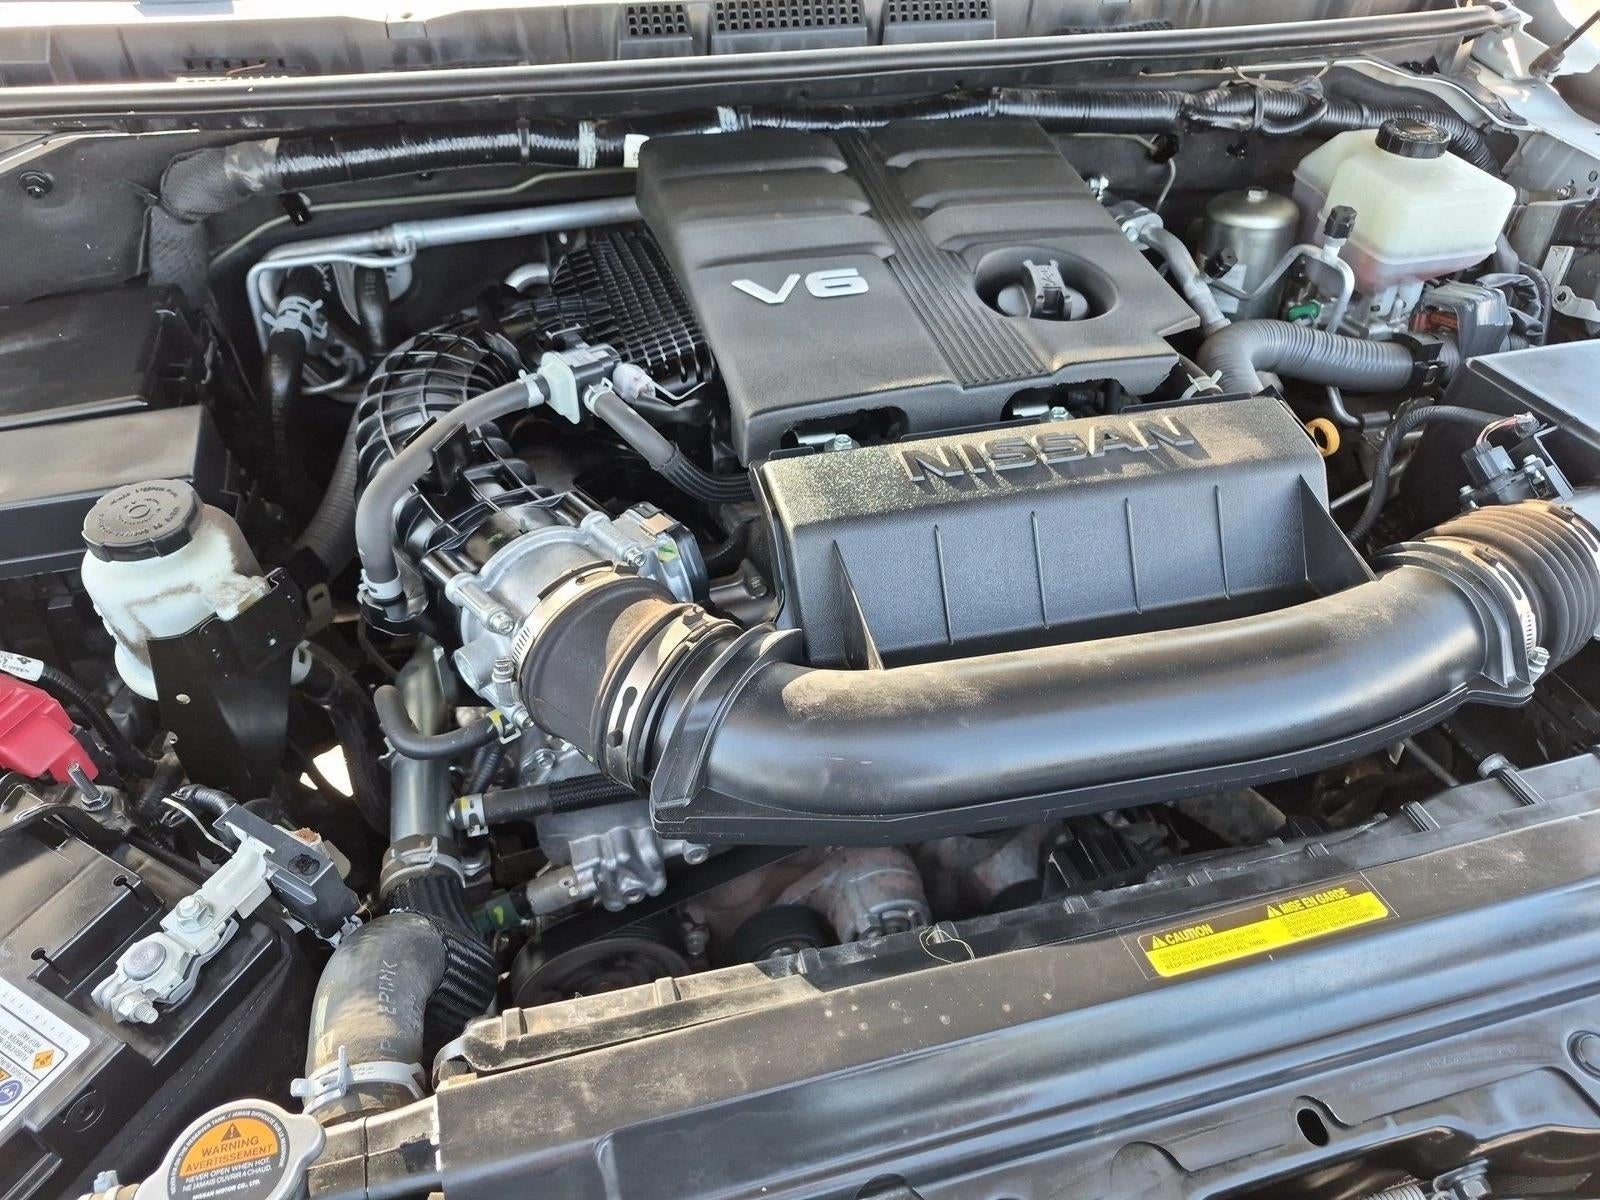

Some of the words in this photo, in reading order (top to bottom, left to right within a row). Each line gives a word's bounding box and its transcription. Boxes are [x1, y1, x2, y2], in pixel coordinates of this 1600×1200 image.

[731, 267, 869, 304] V6
[901, 415, 1194, 482] NISSAN
[1278, 899, 1306, 914] MISE
[1301, 895, 1318, 908] EN
[1315, 887, 1351, 903] GARDE
[1164, 923, 1214, 945] CAUTION
[186, 1144, 273, 1172] AVERTISSEMENT
[202, 1136, 259, 1157] WARNING
[182, 1184, 192, 1192] NE
[192, 1178, 216, 1190] JAMAIS
[216, 1172, 241, 1184] OUVRIR
[186, 1172, 208, 1184] NEVER
[210, 1166, 230, 1177] OPEN
[232, 1161, 254, 1172] WHEN
[192, 1190, 215, 1200] NISSAN
[215, 1184, 236, 1195] MOTOR
